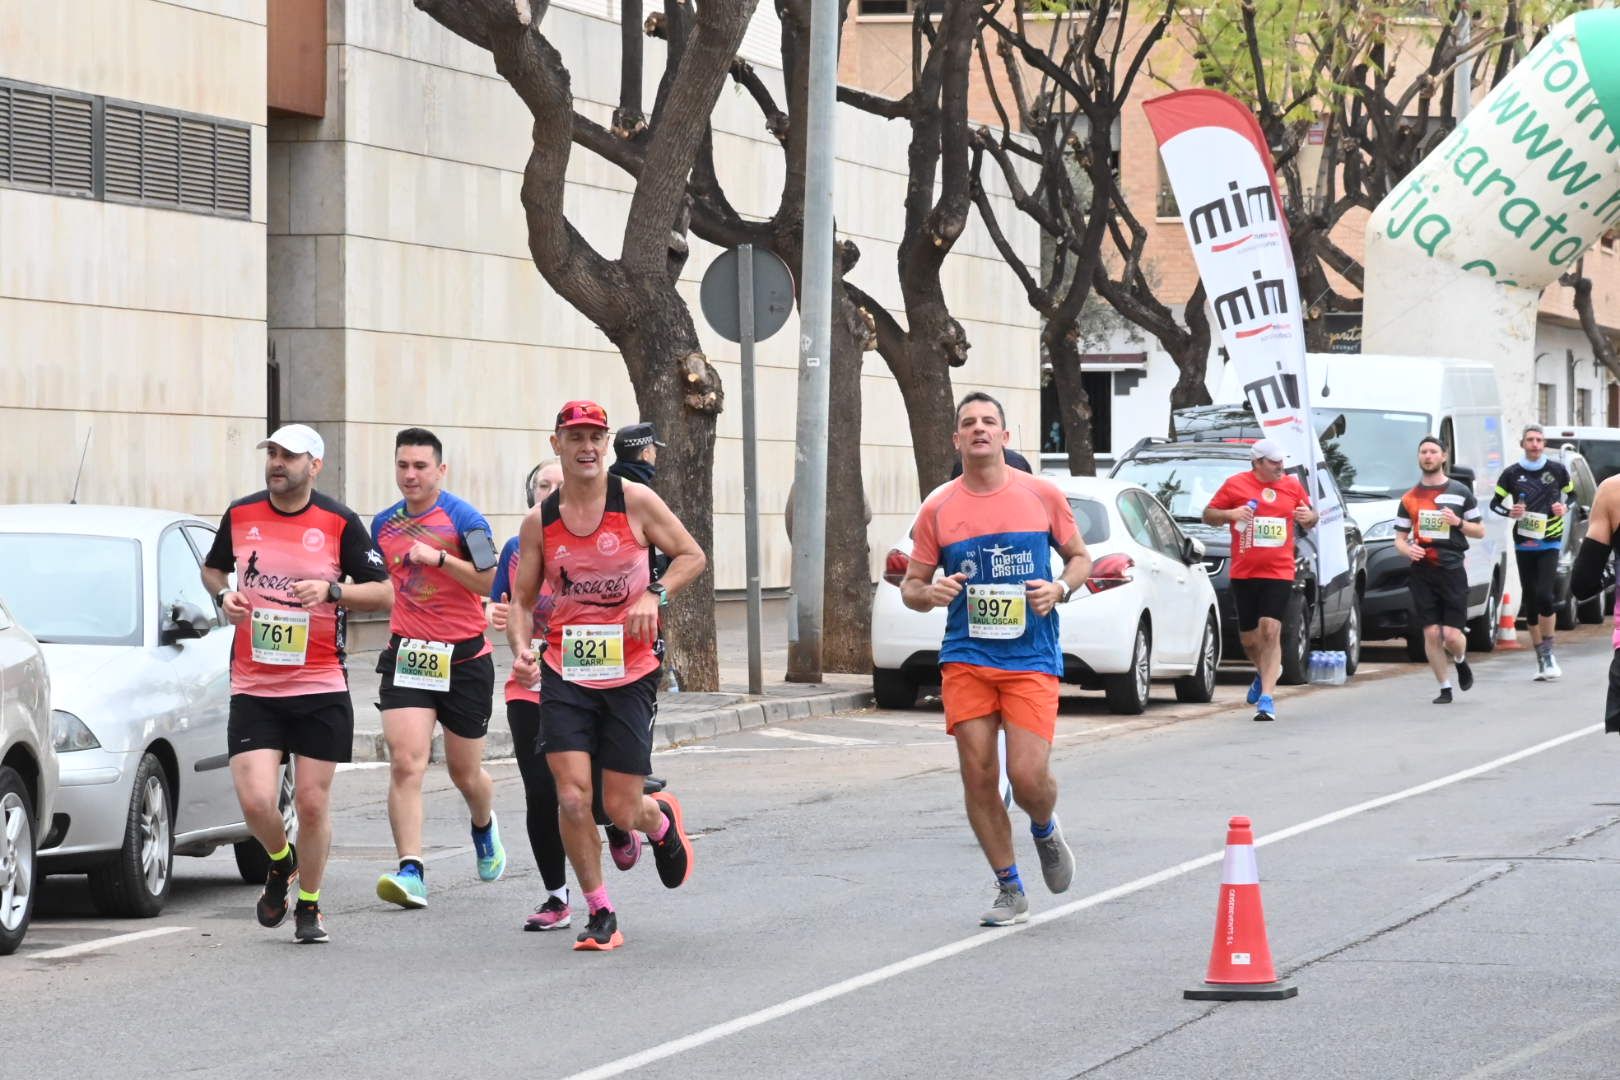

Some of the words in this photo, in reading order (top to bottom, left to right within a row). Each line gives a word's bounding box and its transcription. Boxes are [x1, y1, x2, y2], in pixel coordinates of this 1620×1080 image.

[1189, 180, 1277, 245] mim
[1257, 524, 1283, 536] 1012
[977, 598, 1013, 618] 997
[972, 617, 991, 625] SAUL
[992, 617, 1019, 625] OSCAR
[260, 623, 294, 644] 761
[573, 639, 608, 659] 821
[407, 651, 439, 671] 928
[579, 658, 605, 667] CARRI
[424, 671, 443, 679] VILLA
